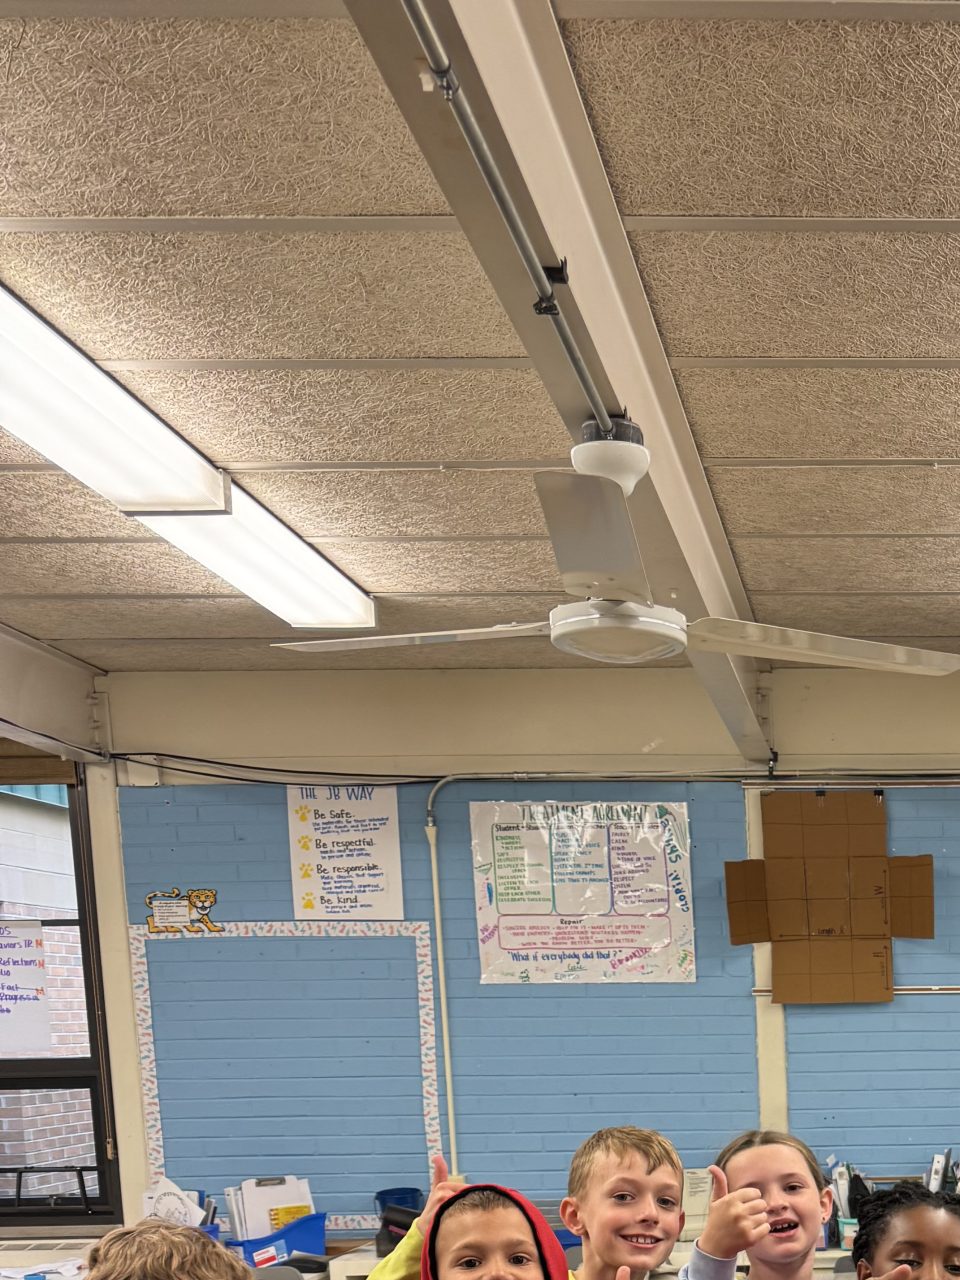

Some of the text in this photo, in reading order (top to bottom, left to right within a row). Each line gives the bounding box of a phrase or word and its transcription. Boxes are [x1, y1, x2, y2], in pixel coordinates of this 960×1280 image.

[299, 786, 375, 800] THE JB WAY
[313, 809, 326, 820] Be
[315, 839, 329, 850] Be
[316, 863, 330, 875] Be
[320, 895, 333, 905] Be
[560, 918, 585, 926] Repair
[542, 951, 581, 964] everybody
